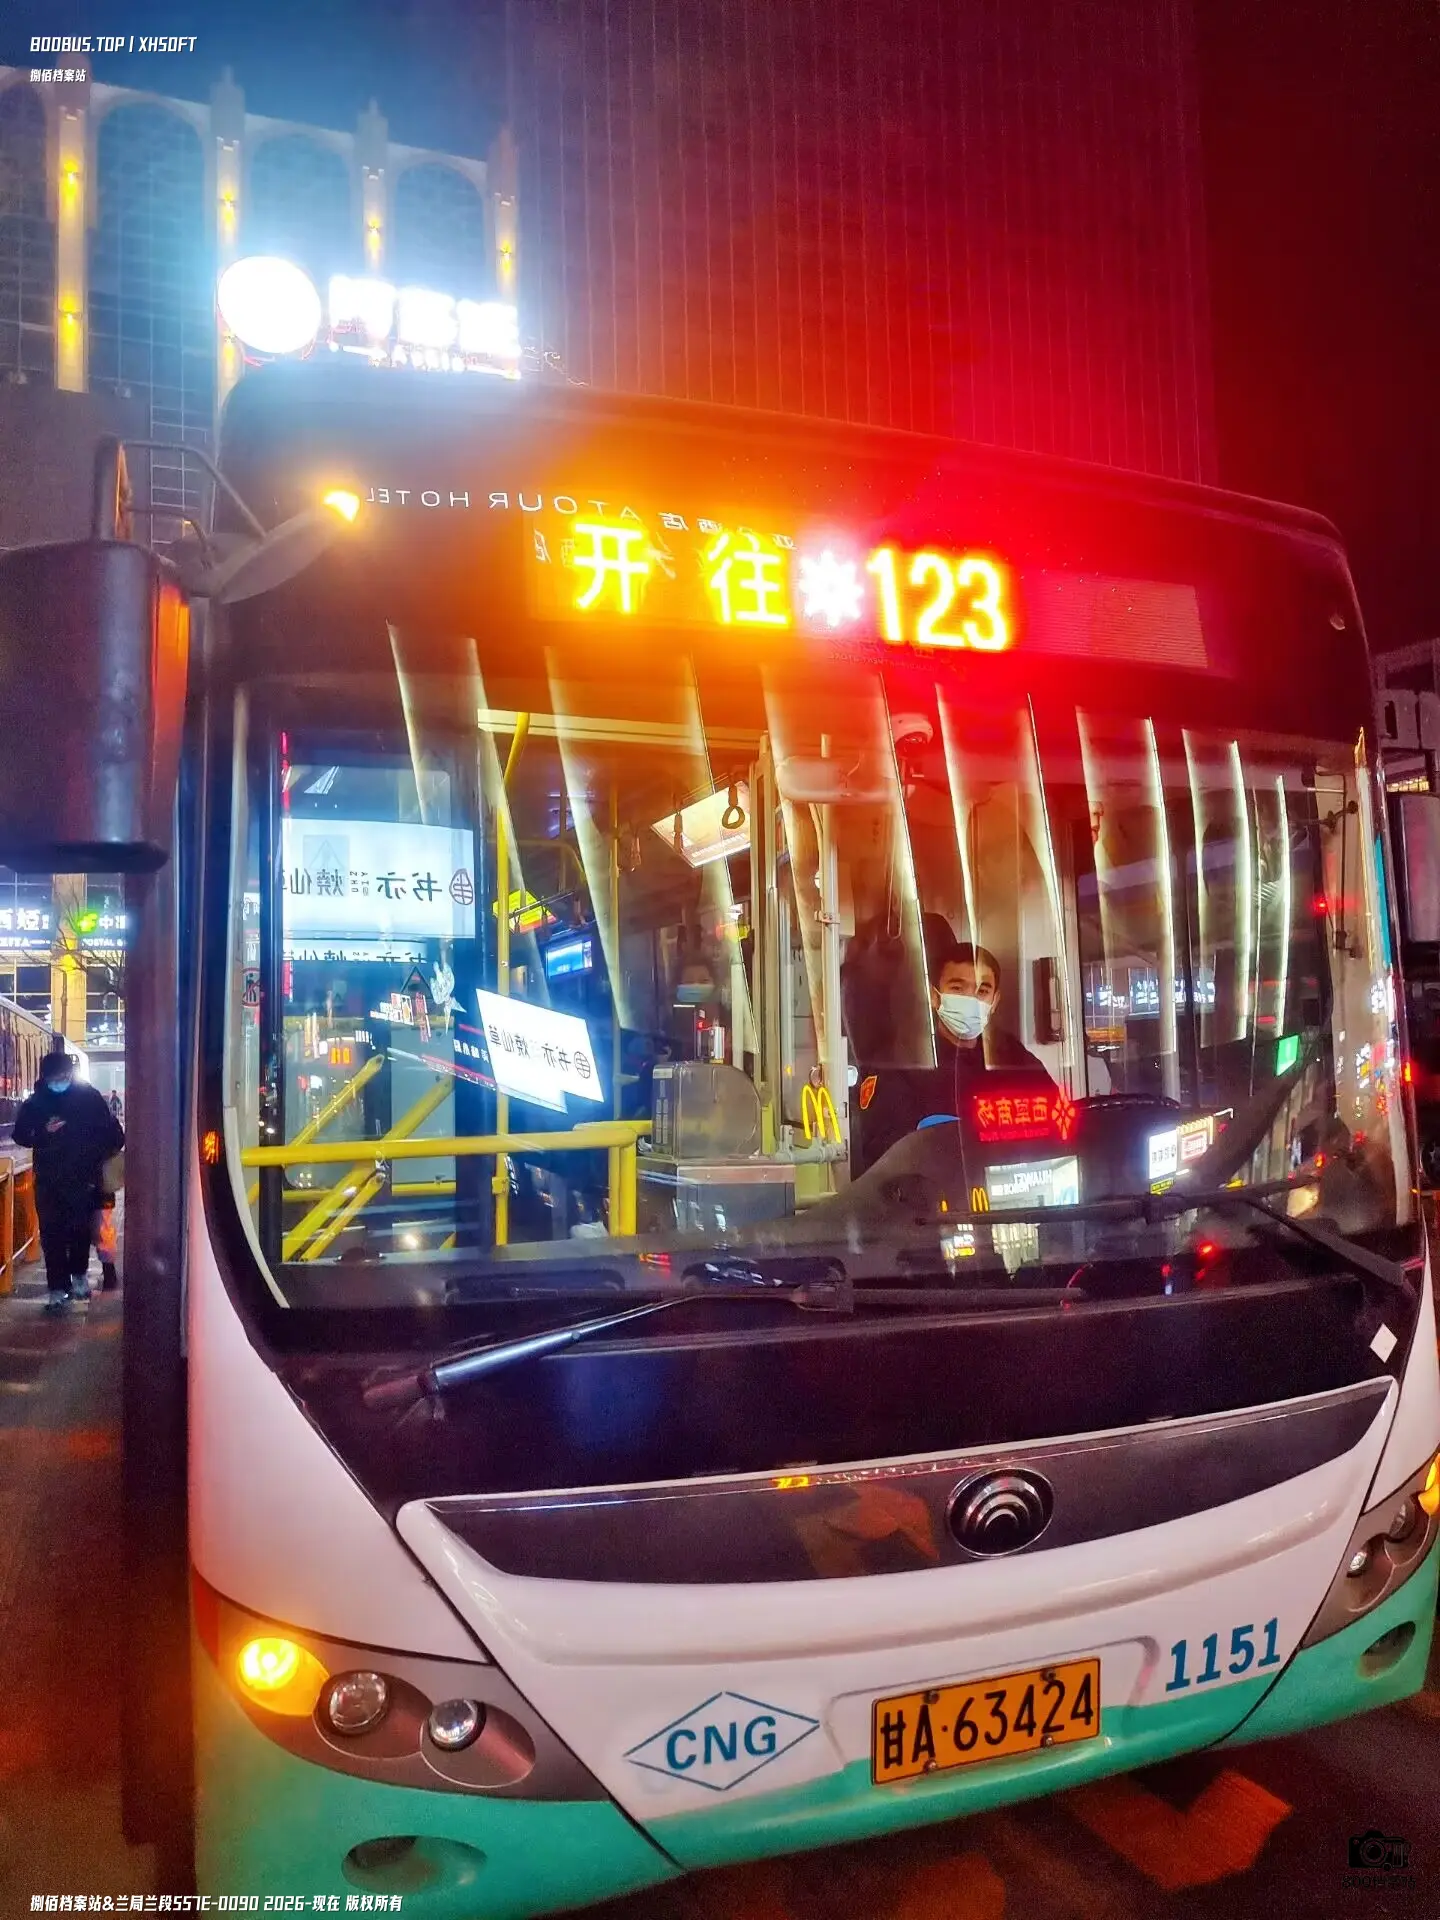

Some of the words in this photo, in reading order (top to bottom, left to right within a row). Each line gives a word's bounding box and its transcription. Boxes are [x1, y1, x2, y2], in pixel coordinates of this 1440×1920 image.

[572, 522, 790, 628] 开往
[868, 546, 1010, 652] 123
[1165, 1616, 1281, 1693] 1151
[665, 1715, 778, 1772] CNG
